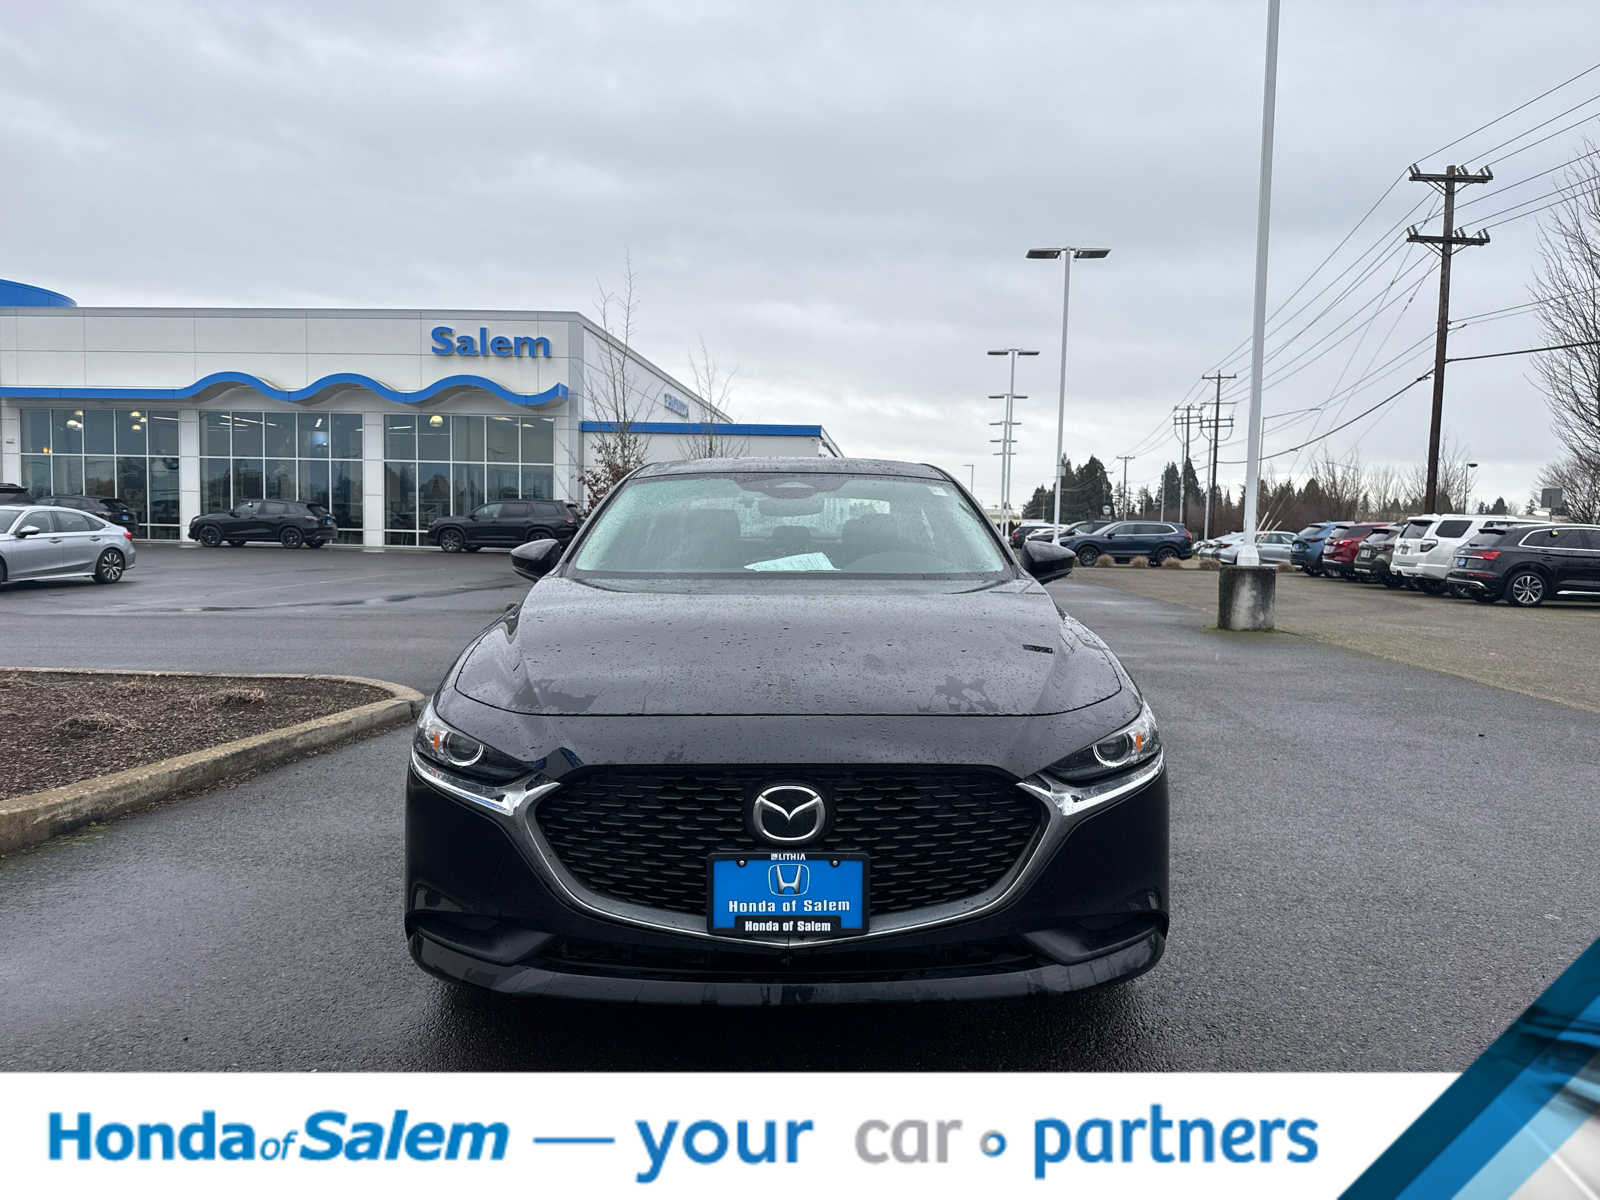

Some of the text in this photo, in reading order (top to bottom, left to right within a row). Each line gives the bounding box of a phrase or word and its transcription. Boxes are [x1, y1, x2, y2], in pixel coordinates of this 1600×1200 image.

[431, 325, 552, 358] Salem
[778, 853, 806, 861] LITHIA
[728, 899, 850, 912] Honda of Salem
[744, 920, 831, 932] Honda of Salem
